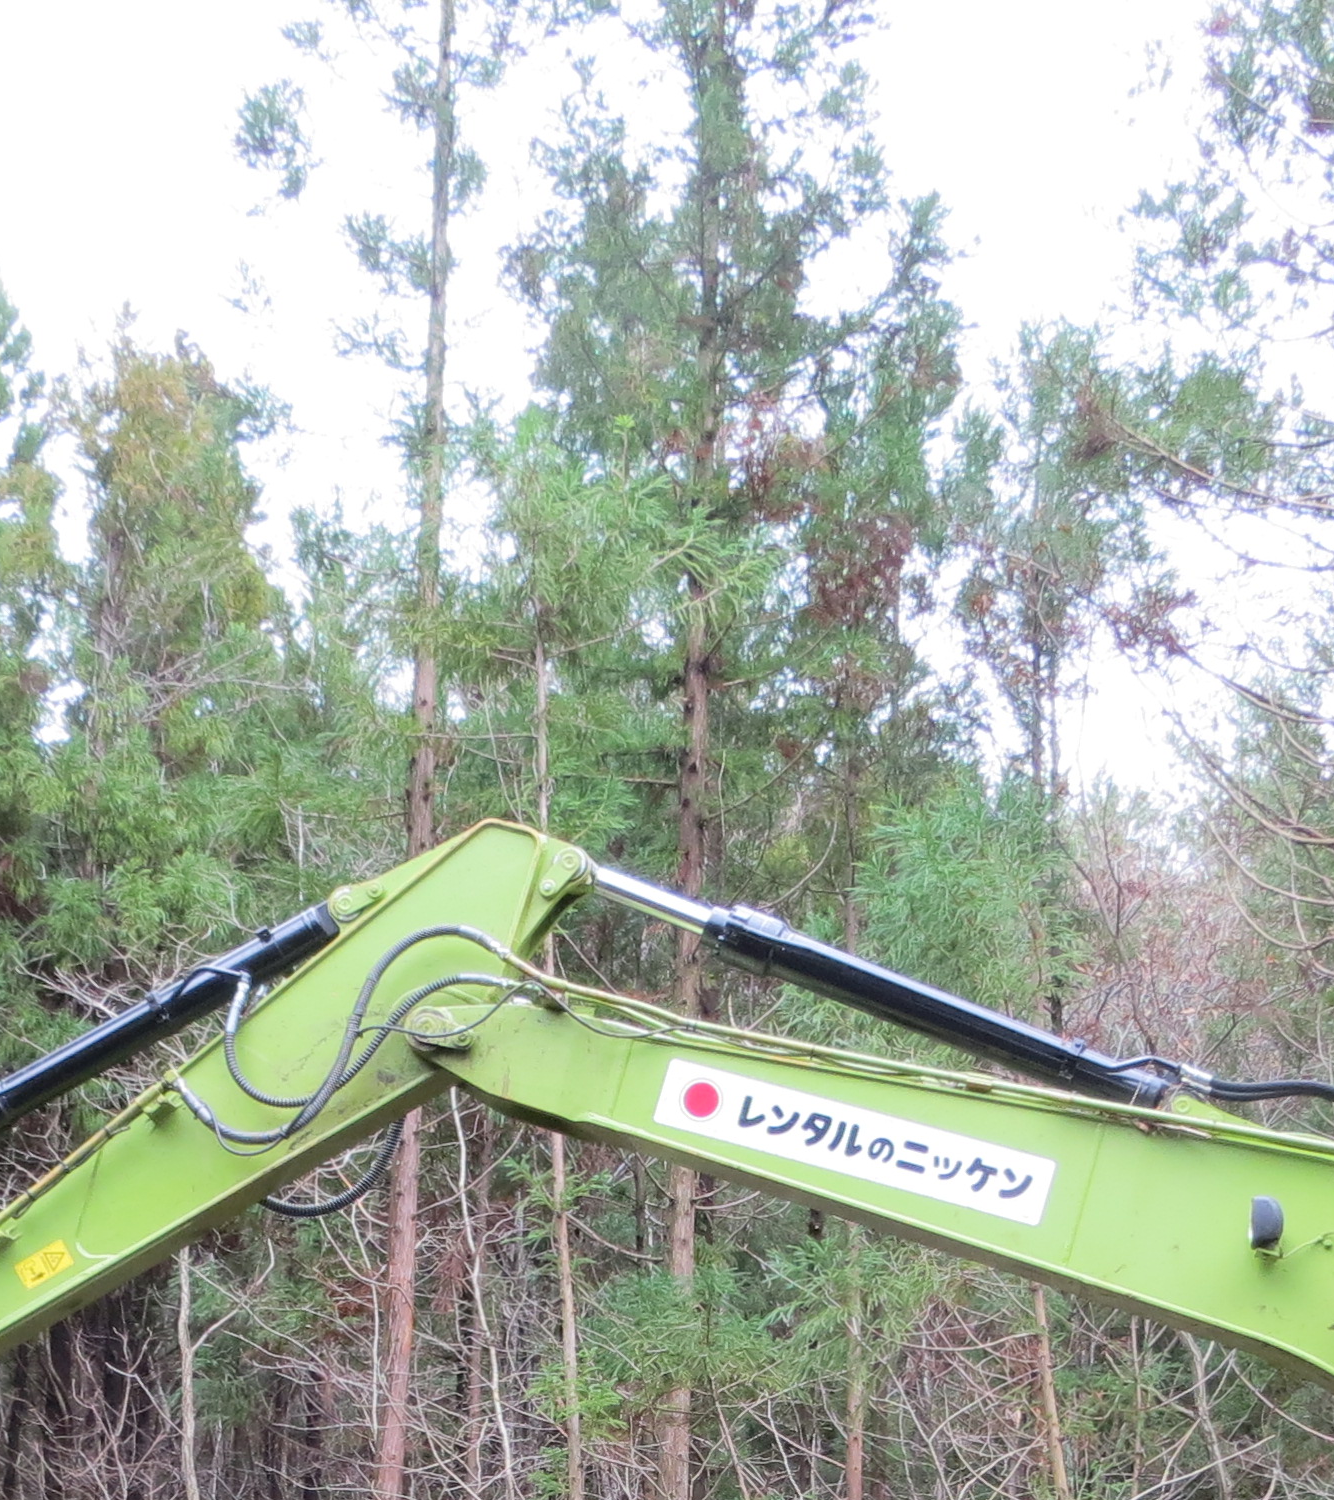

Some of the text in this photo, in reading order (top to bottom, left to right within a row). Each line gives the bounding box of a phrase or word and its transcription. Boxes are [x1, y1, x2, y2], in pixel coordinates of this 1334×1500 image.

[738, 1095, 1033, 1199] レンタルのニッケン
